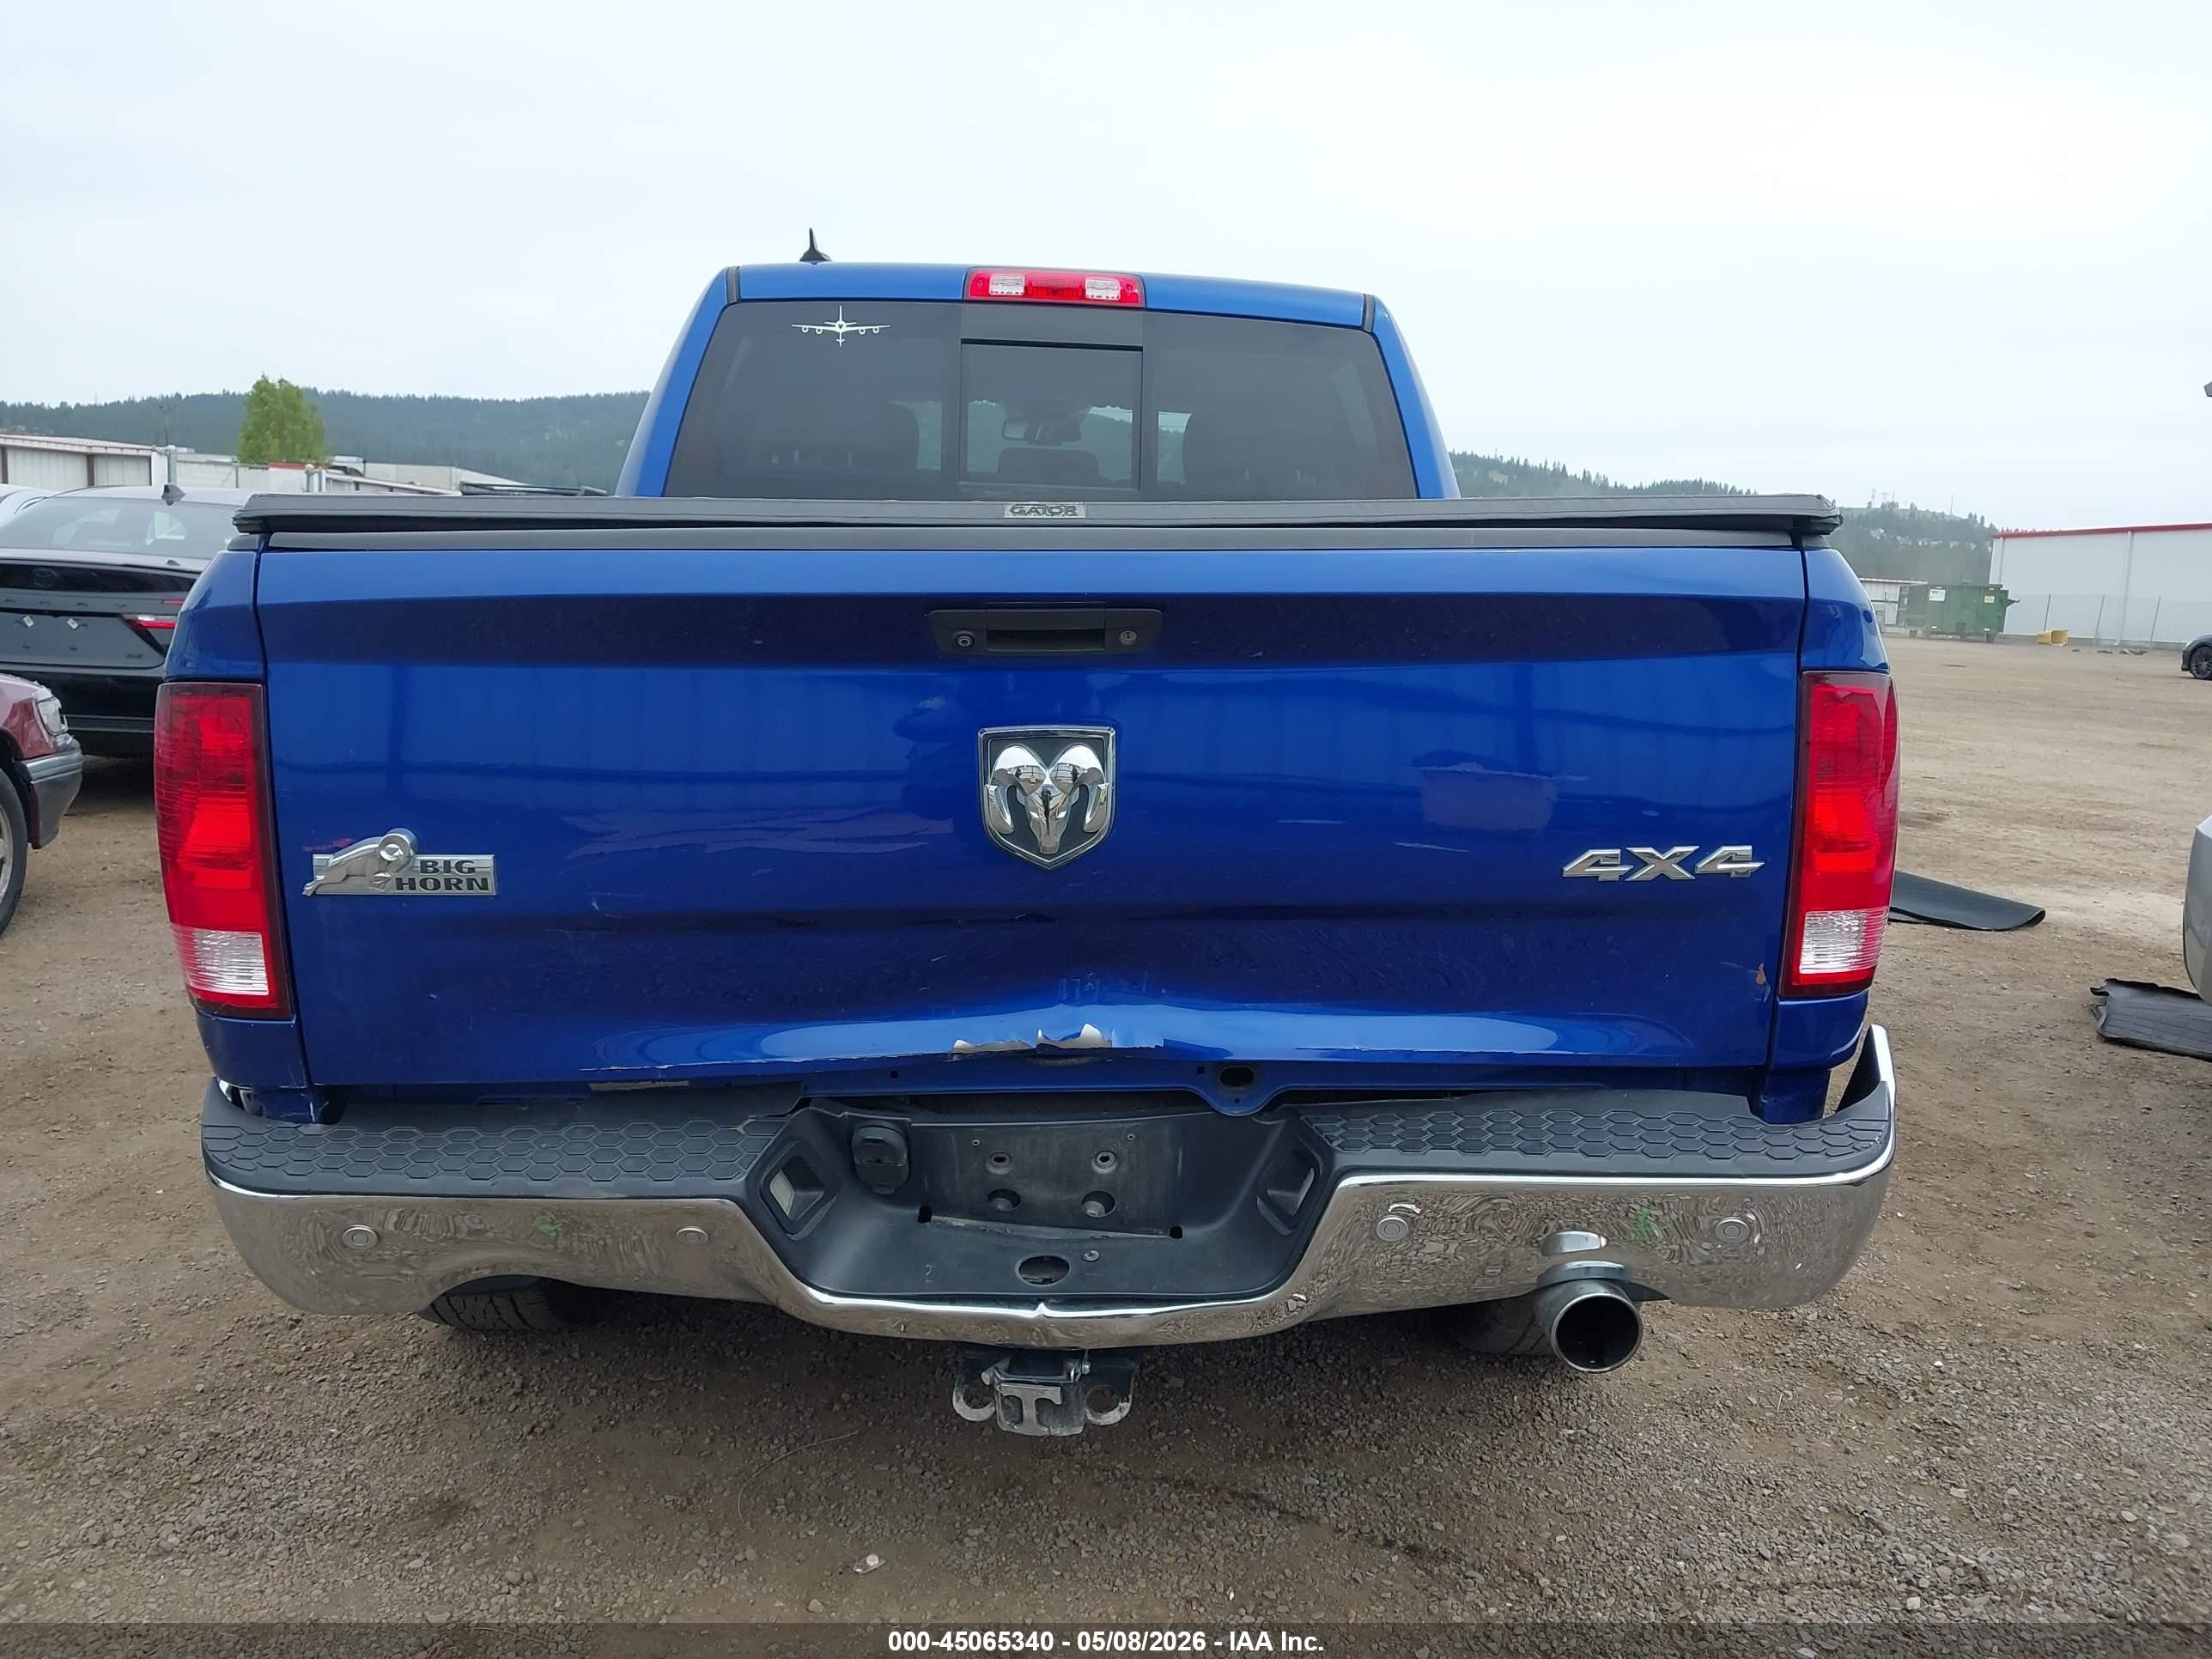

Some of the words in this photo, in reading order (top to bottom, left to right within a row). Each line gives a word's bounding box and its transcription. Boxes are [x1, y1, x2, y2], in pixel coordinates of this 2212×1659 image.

[1009, 503, 1079, 516] GATOR
[420, 860, 476, 874] BIG
[1563, 845, 1765, 882] 4X4
[395, 877, 489, 891] HORN
